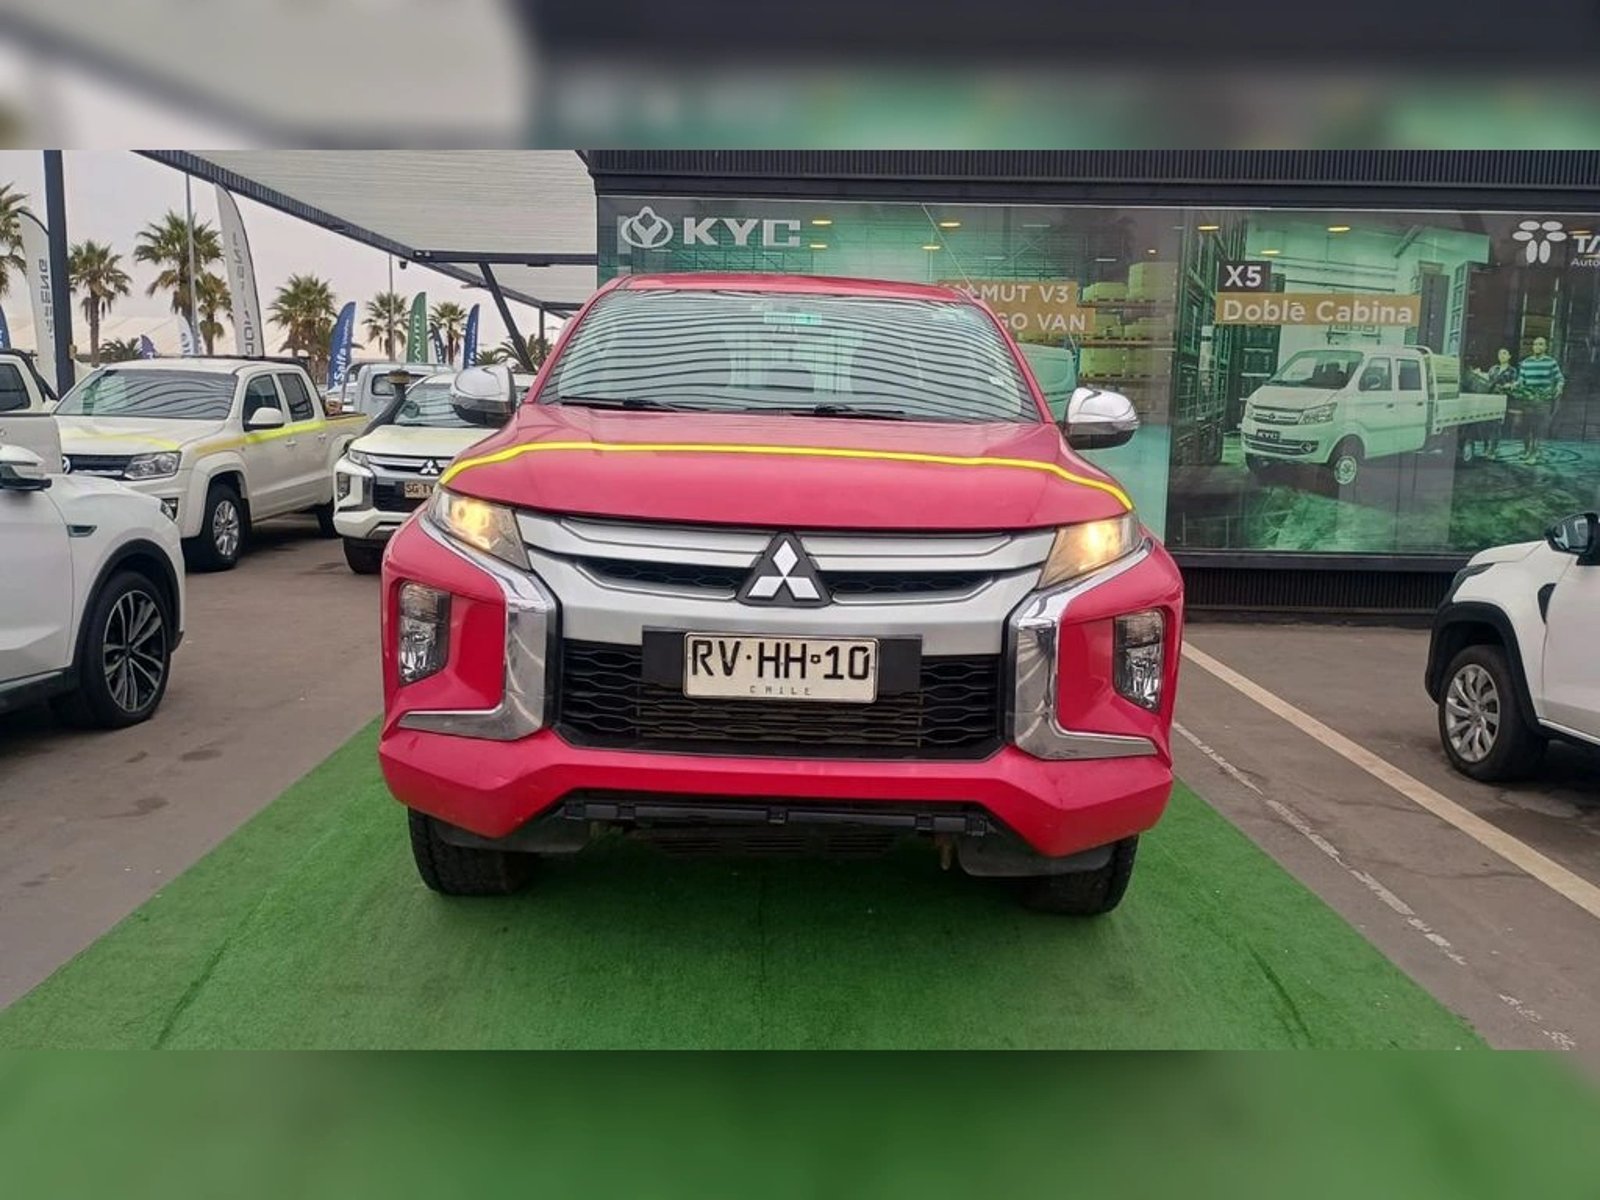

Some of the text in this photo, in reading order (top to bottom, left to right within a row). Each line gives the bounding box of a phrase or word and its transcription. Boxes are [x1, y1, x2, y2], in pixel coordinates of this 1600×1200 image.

[683, 216, 801, 246] KYC
[1225, 265, 1262, 287] X5
[1039, 285, 1069, 303] V3
[1037, 313, 1086, 331] VAN
[1223, 299, 1413, 323] Doble Cabina
